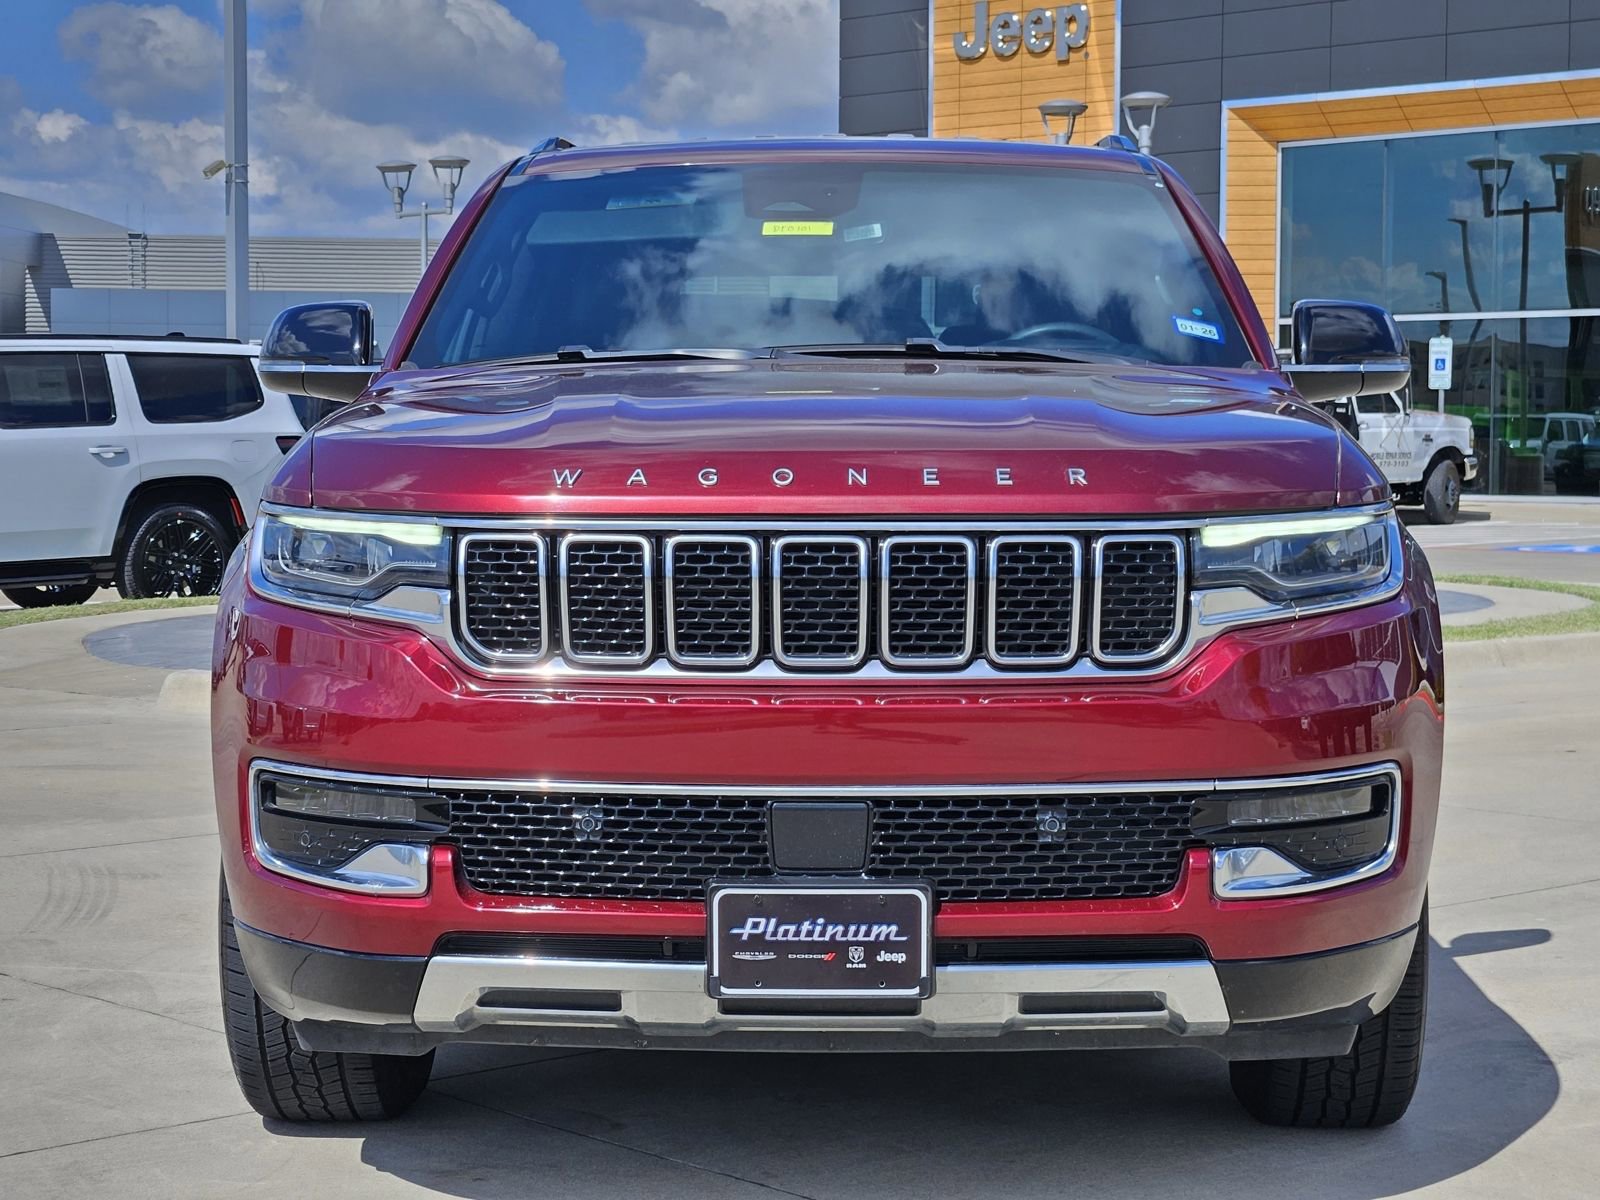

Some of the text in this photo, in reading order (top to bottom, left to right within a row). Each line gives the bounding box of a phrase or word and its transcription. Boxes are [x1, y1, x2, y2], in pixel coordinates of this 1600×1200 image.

[953, 0, 1091, 61] Jeep
[553, 467, 1089, 488] WAGONEER
[729, 917, 908, 941] Platinum
[876, 950, 907, 964] Jeep
